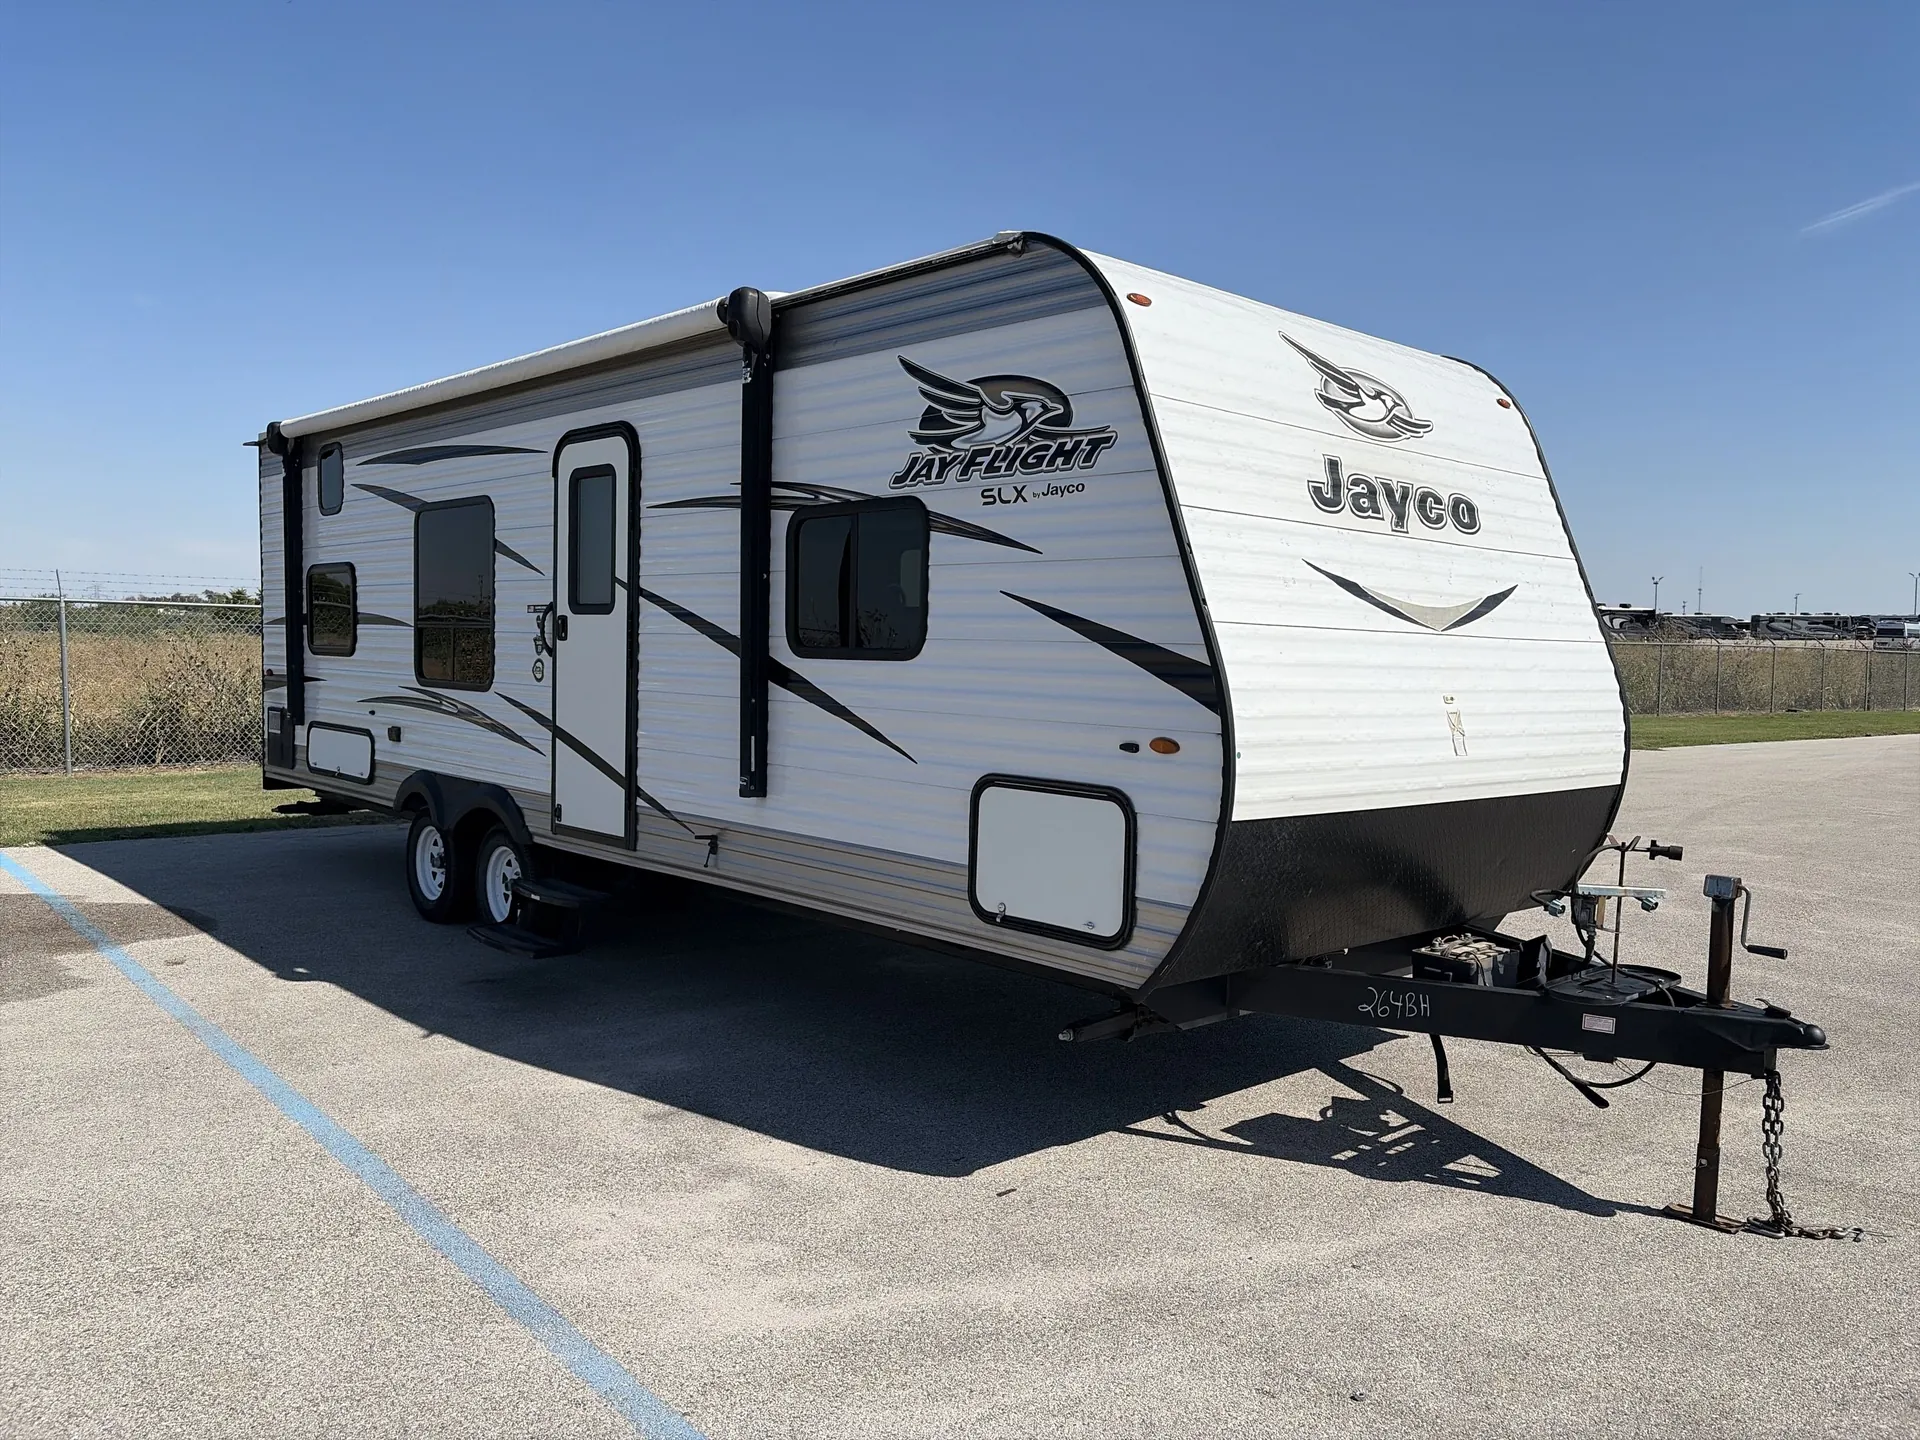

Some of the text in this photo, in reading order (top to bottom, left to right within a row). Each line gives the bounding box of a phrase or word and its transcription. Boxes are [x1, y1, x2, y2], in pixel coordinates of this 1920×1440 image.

[980, 483, 1086, 506] SLX by Jayco
[1307, 454, 1481, 535] Jayco
[1358, 986, 1430, 1019] 264BH
